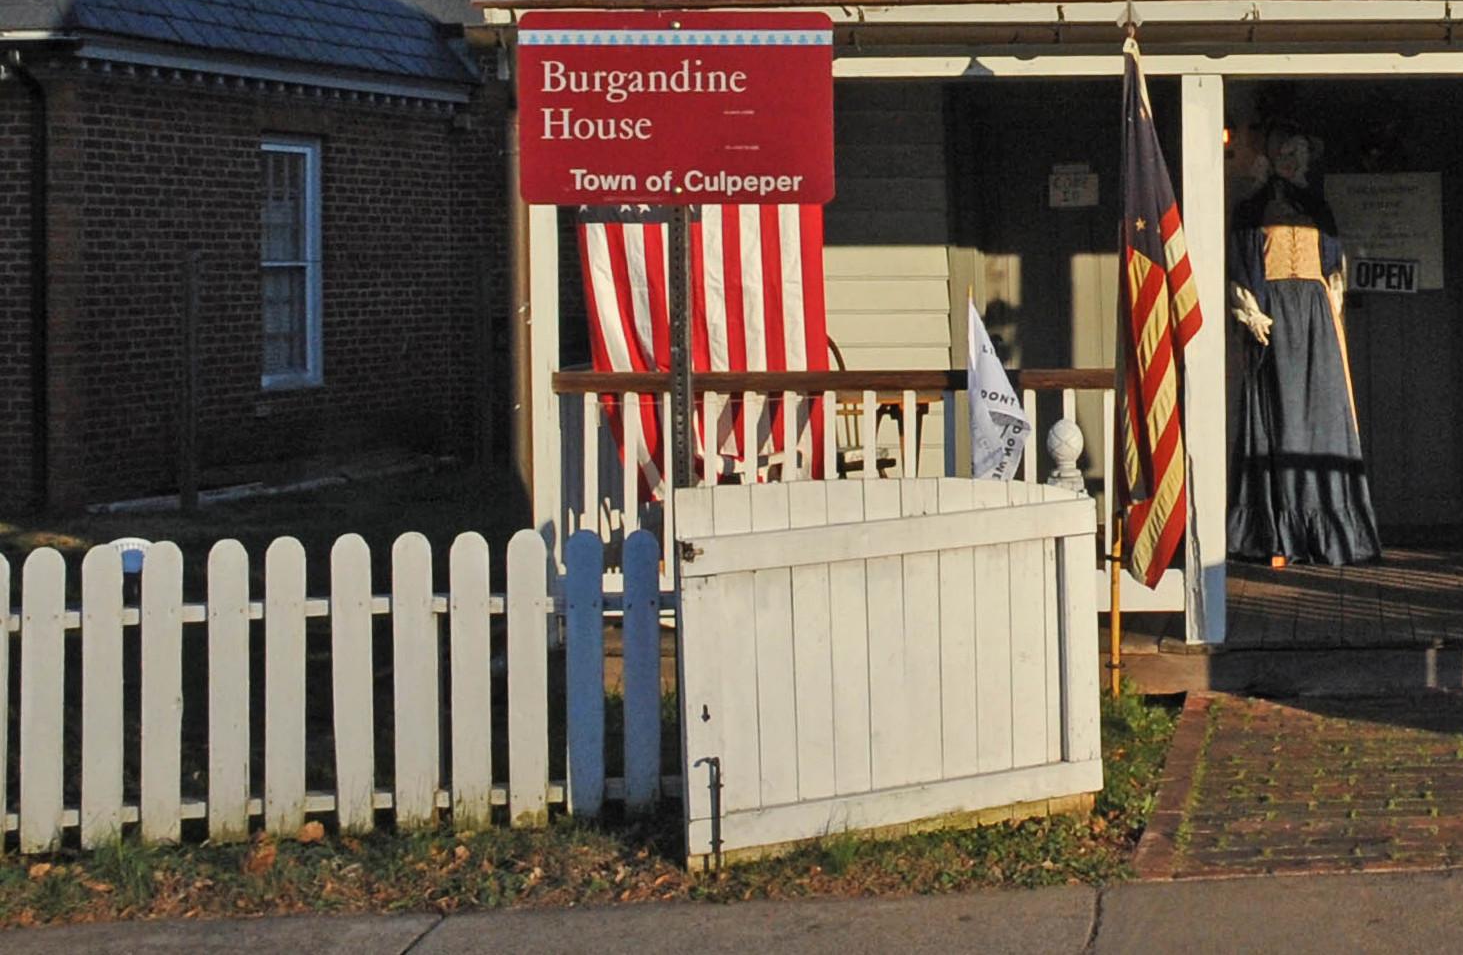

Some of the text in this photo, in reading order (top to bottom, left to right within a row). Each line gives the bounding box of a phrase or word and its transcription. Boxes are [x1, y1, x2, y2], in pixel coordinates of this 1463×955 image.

[541, 59, 747, 103] Burgandine
[541, 108, 652, 140] House
[570, 169, 802, 196] Town of Culpeper
[1356, 262, 1414, 290] OPEN
